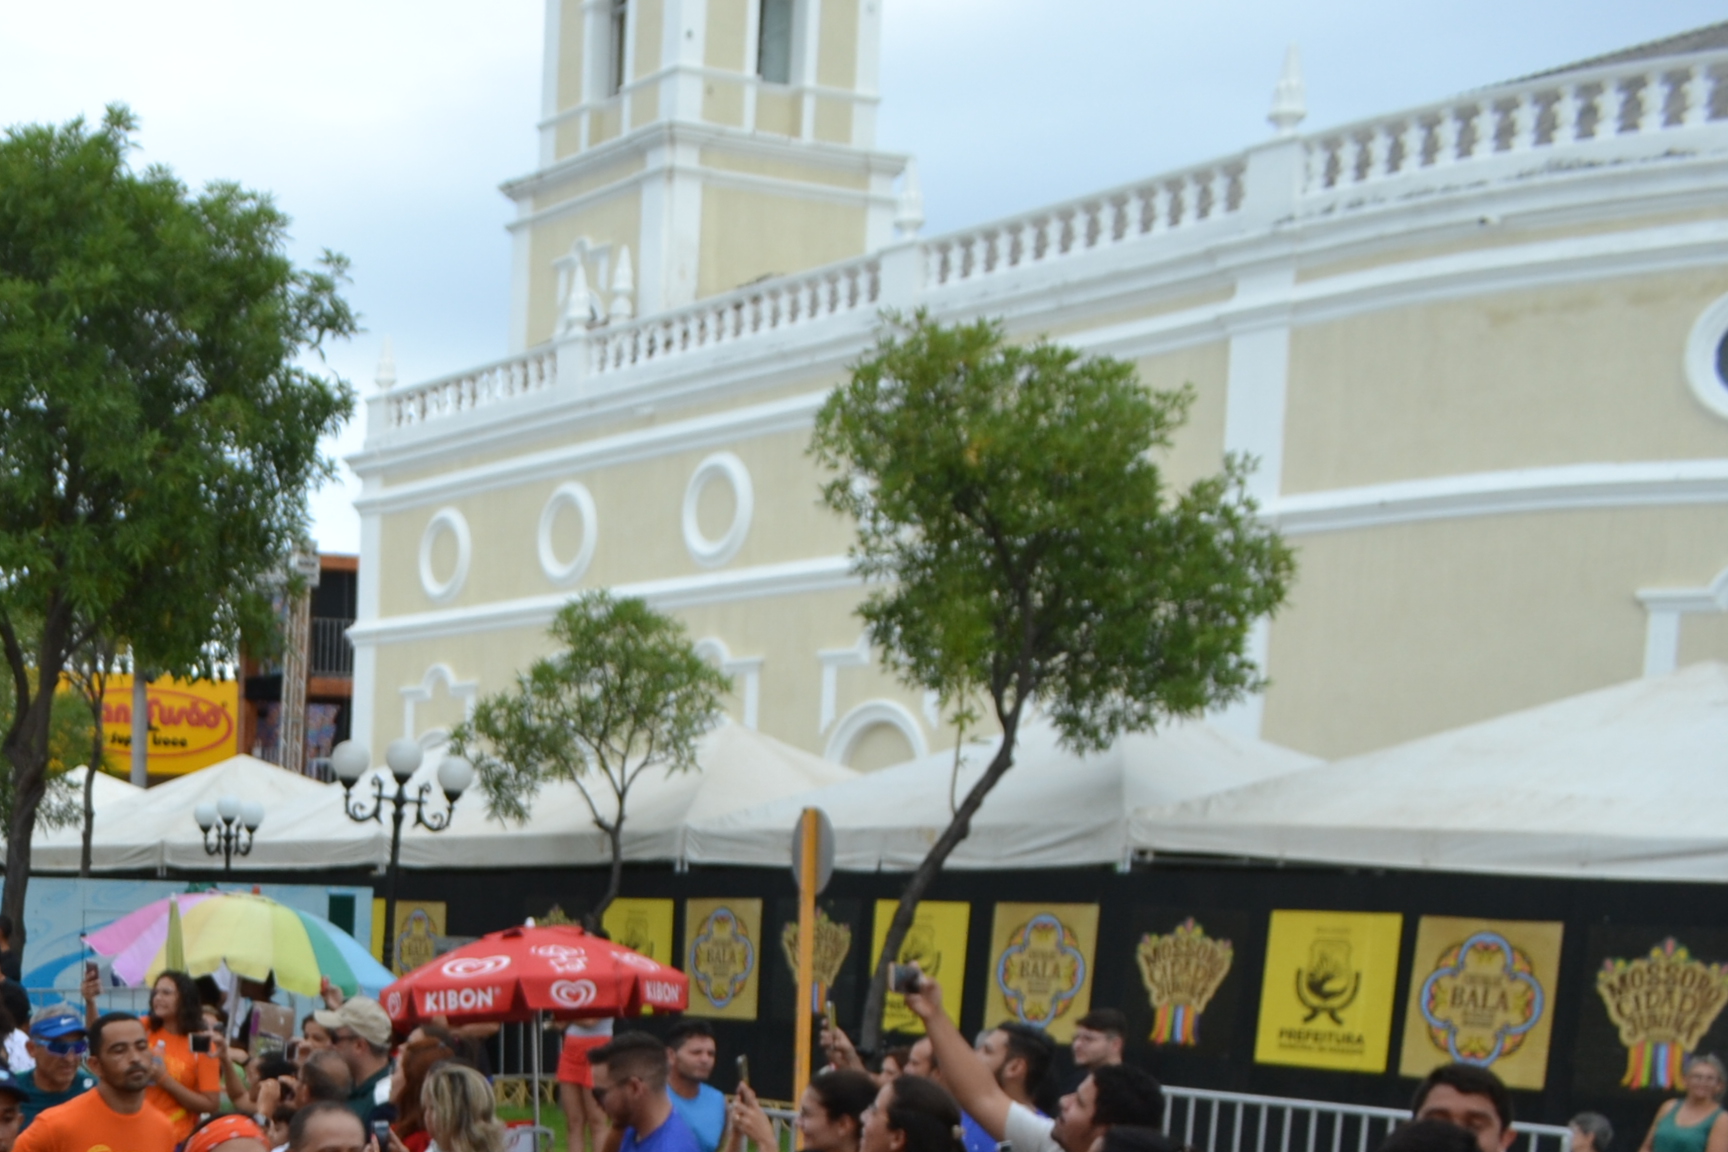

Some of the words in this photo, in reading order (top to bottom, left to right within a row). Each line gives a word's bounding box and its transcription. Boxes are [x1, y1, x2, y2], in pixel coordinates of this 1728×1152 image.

[425, 987, 494, 1012] KIBON
[645, 980, 679, 1002] KIBON
[1279, 1027, 1365, 1045] PREFEITURA
